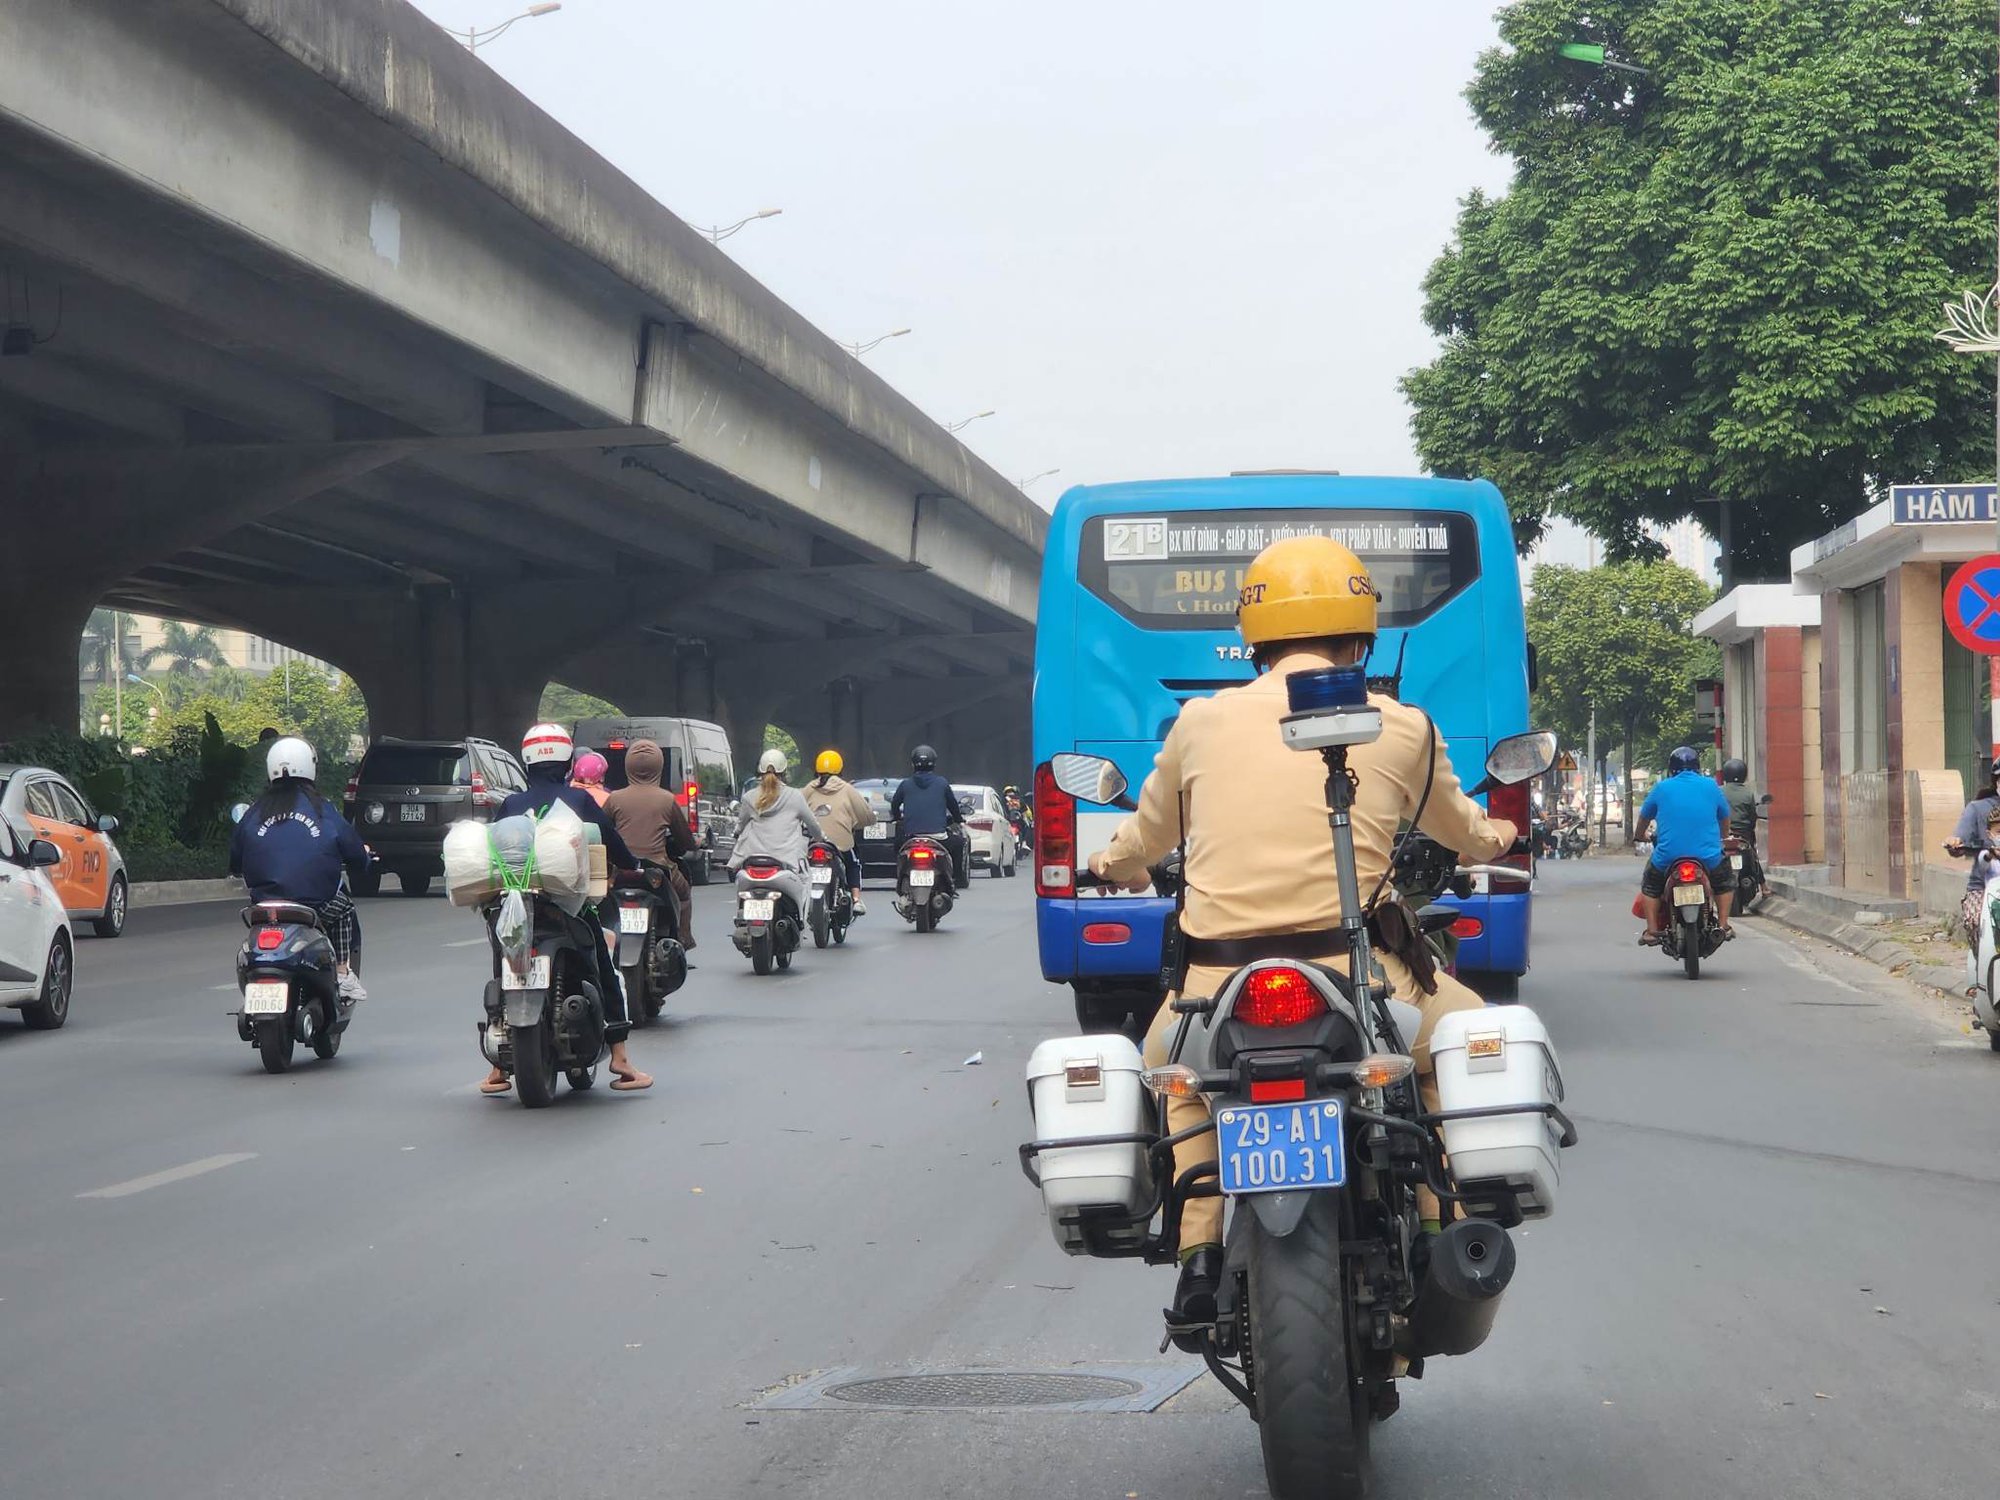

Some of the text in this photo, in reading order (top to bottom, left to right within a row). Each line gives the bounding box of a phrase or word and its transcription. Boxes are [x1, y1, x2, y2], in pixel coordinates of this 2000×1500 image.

[1906, 488, 1975, 520] HẦM
[1169, 530, 1181, 552] BX
[1197, 526, 1218, 551] ĐÌNH
[1226, 525, 1246, 551] GIÁP
[1247, 524, 1264, 551] BÁT
[1372, 523, 1391, 550] VÂN
[1399, 523, 1427, 550] DUYÊN
[1427, 523, 1448, 550] THÁI
[1176, 569, 1226, 593] BUS
[1236, 1106, 1321, 1147] 29-A1
[1230, 1144, 1335, 1187] 100.31
